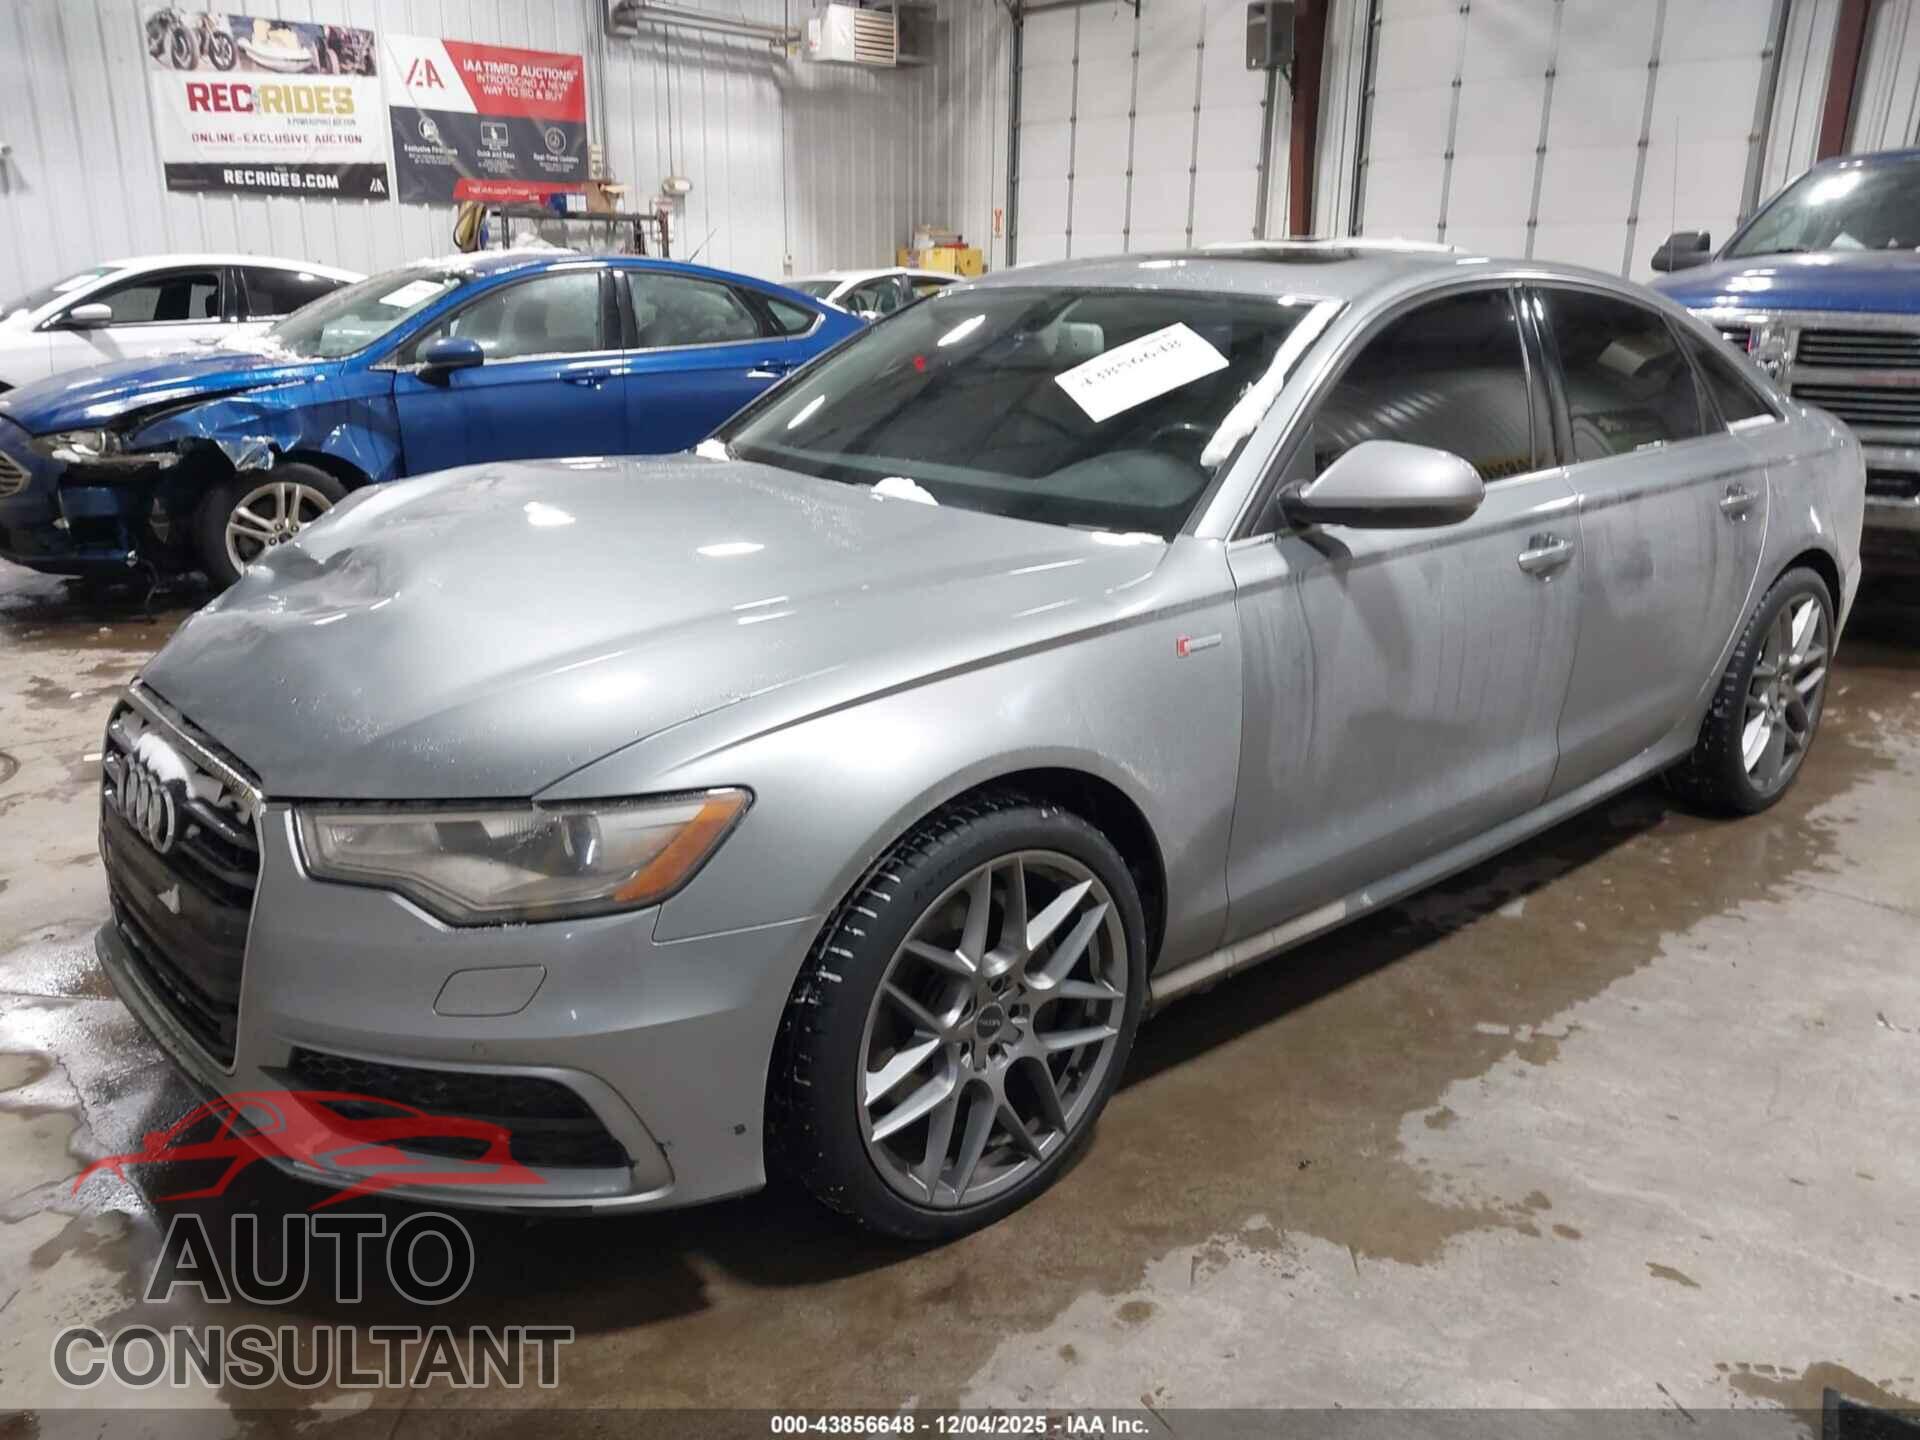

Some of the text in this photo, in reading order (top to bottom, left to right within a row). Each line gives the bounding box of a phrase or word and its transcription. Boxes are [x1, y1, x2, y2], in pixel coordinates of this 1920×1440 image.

[463, 58, 483, 72] IAA
[483, 61, 518, 76] TIMED
[476, 73, 537, 88] INTRODUCING
[186, 82, 355, 115] REC RIDES
[482, 85, 504, 96] WAY
[506, 87, 519, 97] TO
[545, 90, 563, 101] BUY
[314, 133, 363, 144] AUCTION
[223, 168, 340, 190] RECRIDES.COM
